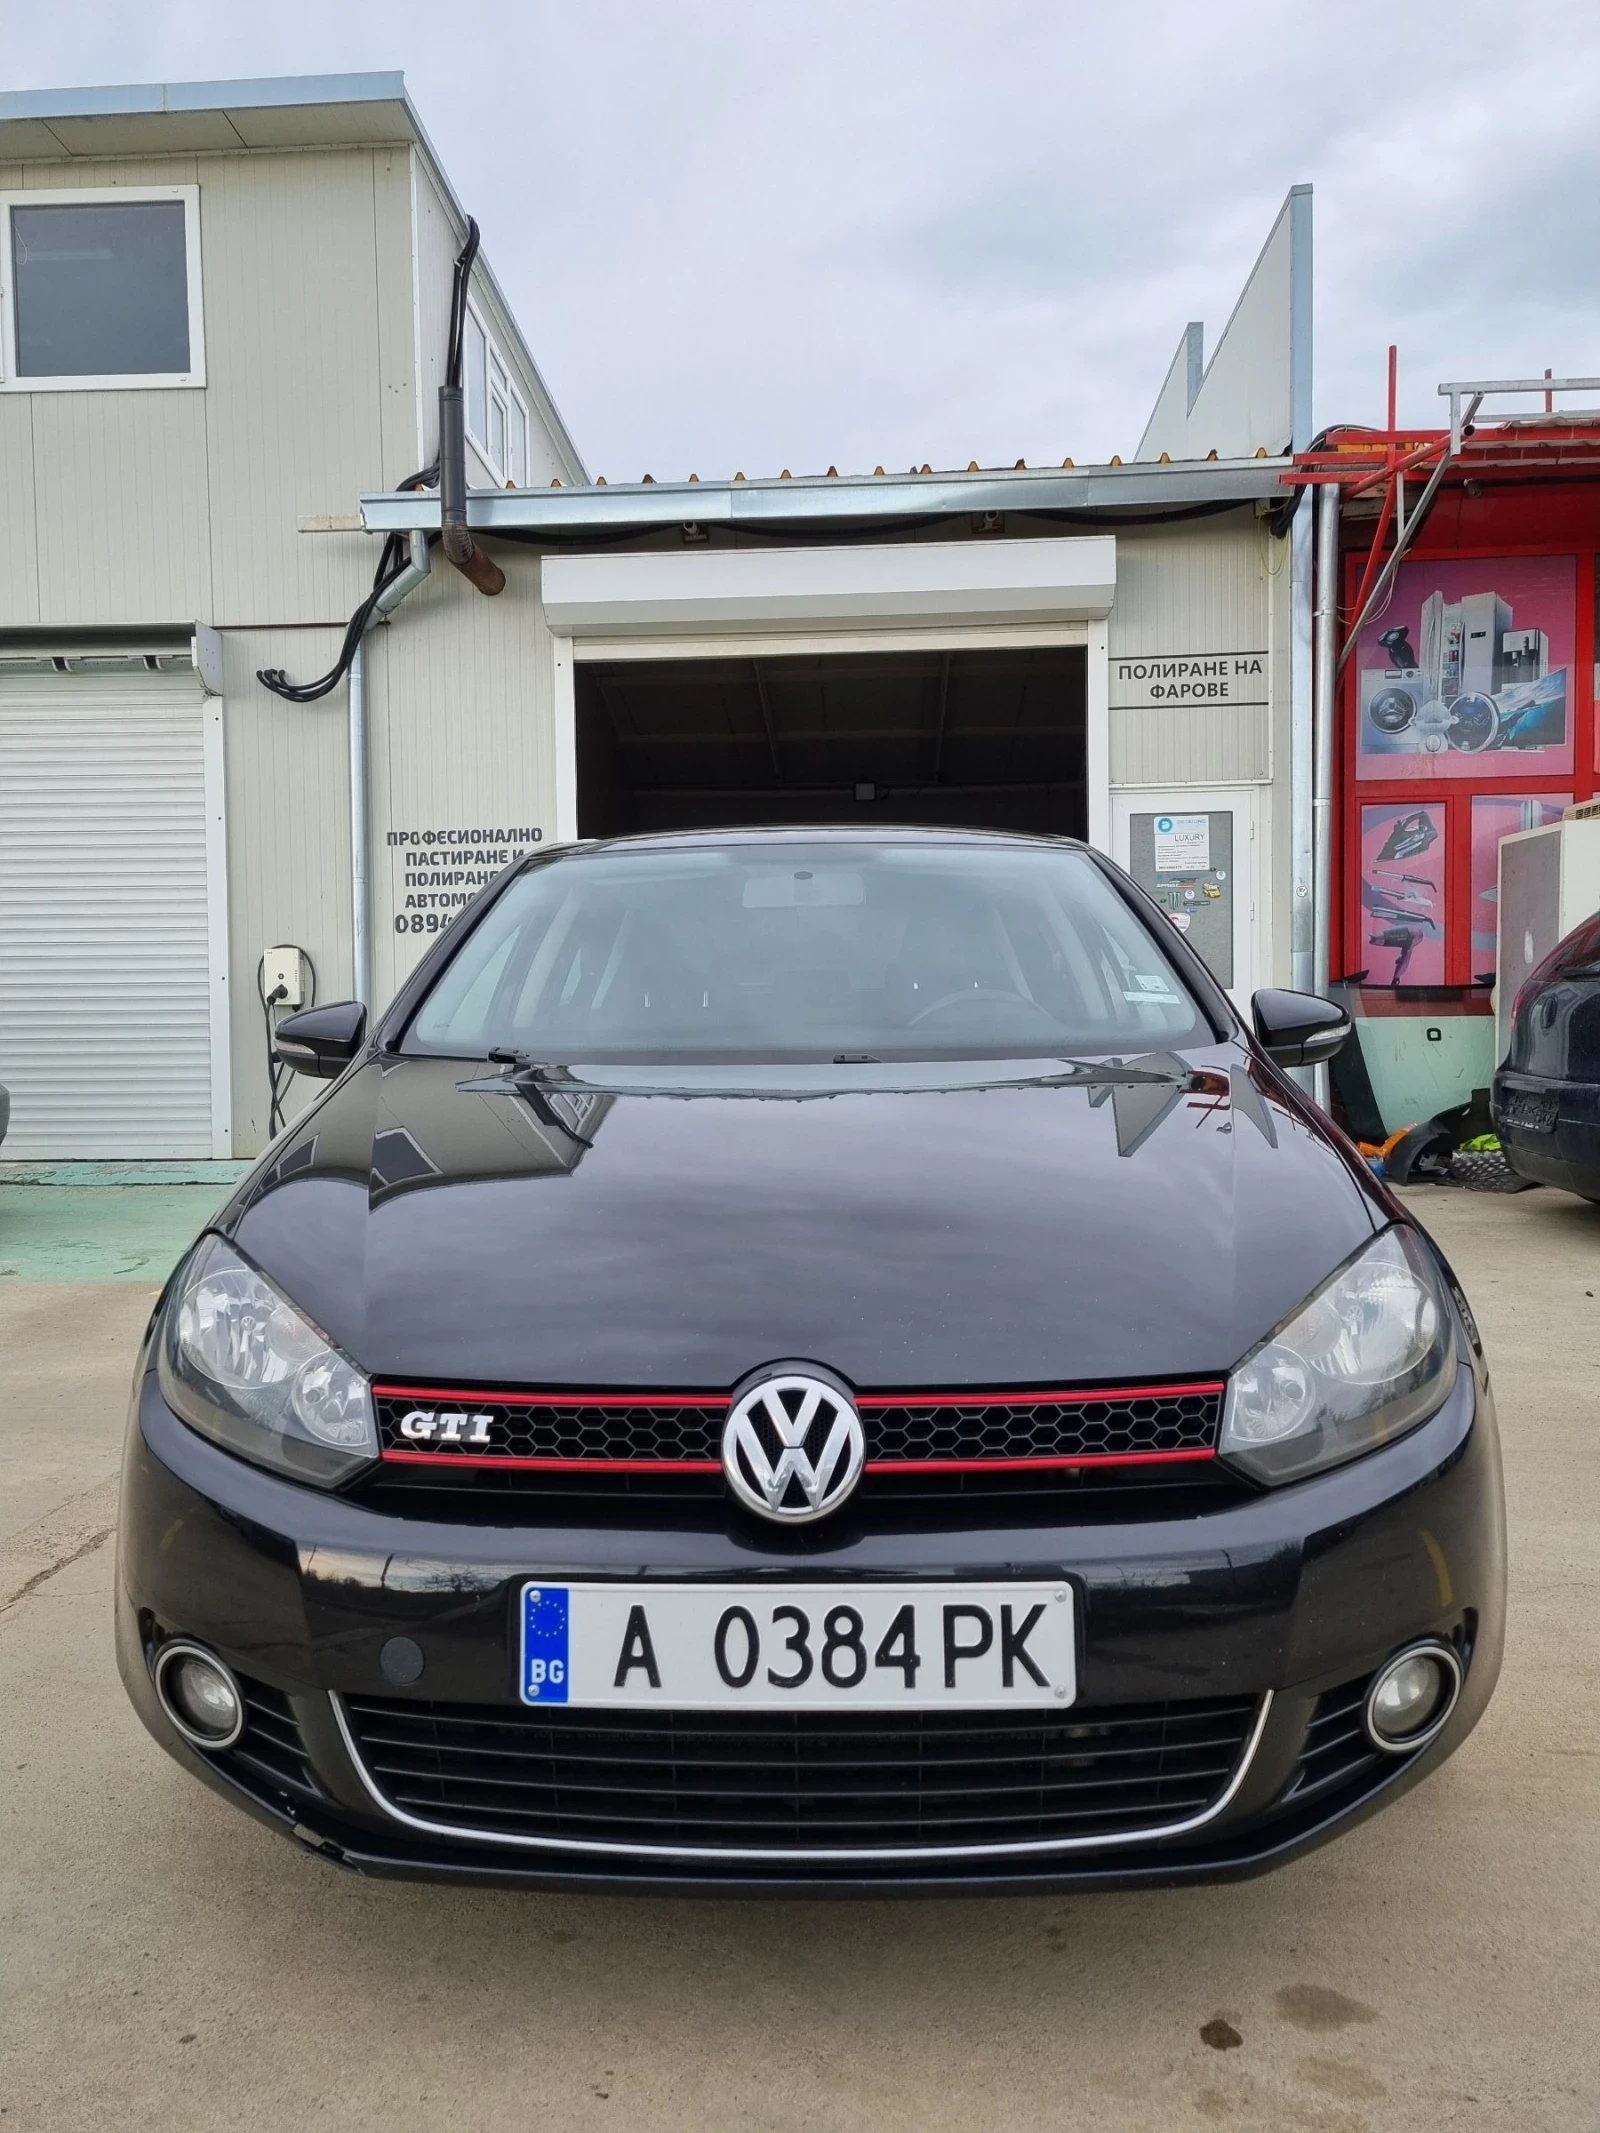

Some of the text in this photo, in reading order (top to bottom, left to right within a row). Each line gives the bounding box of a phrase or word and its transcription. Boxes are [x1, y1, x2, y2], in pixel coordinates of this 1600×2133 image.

[1119, 660, 1263, 680] ПОЛИРАНЕ НА
[1150, 682, 1229, 699] ФАРОВЕ
[387, 828, 543, 846] ПРОФЕСИОНАЛНО
[1174, 833, 1205, 842] LUXURY
[405, 850, 508, 867] ПАСТИРАНЕ
[400, 1411, 494, 1444] GTI
[613, 1604, 662, 1688] A
[530, 1659, 564, 1685] BG
